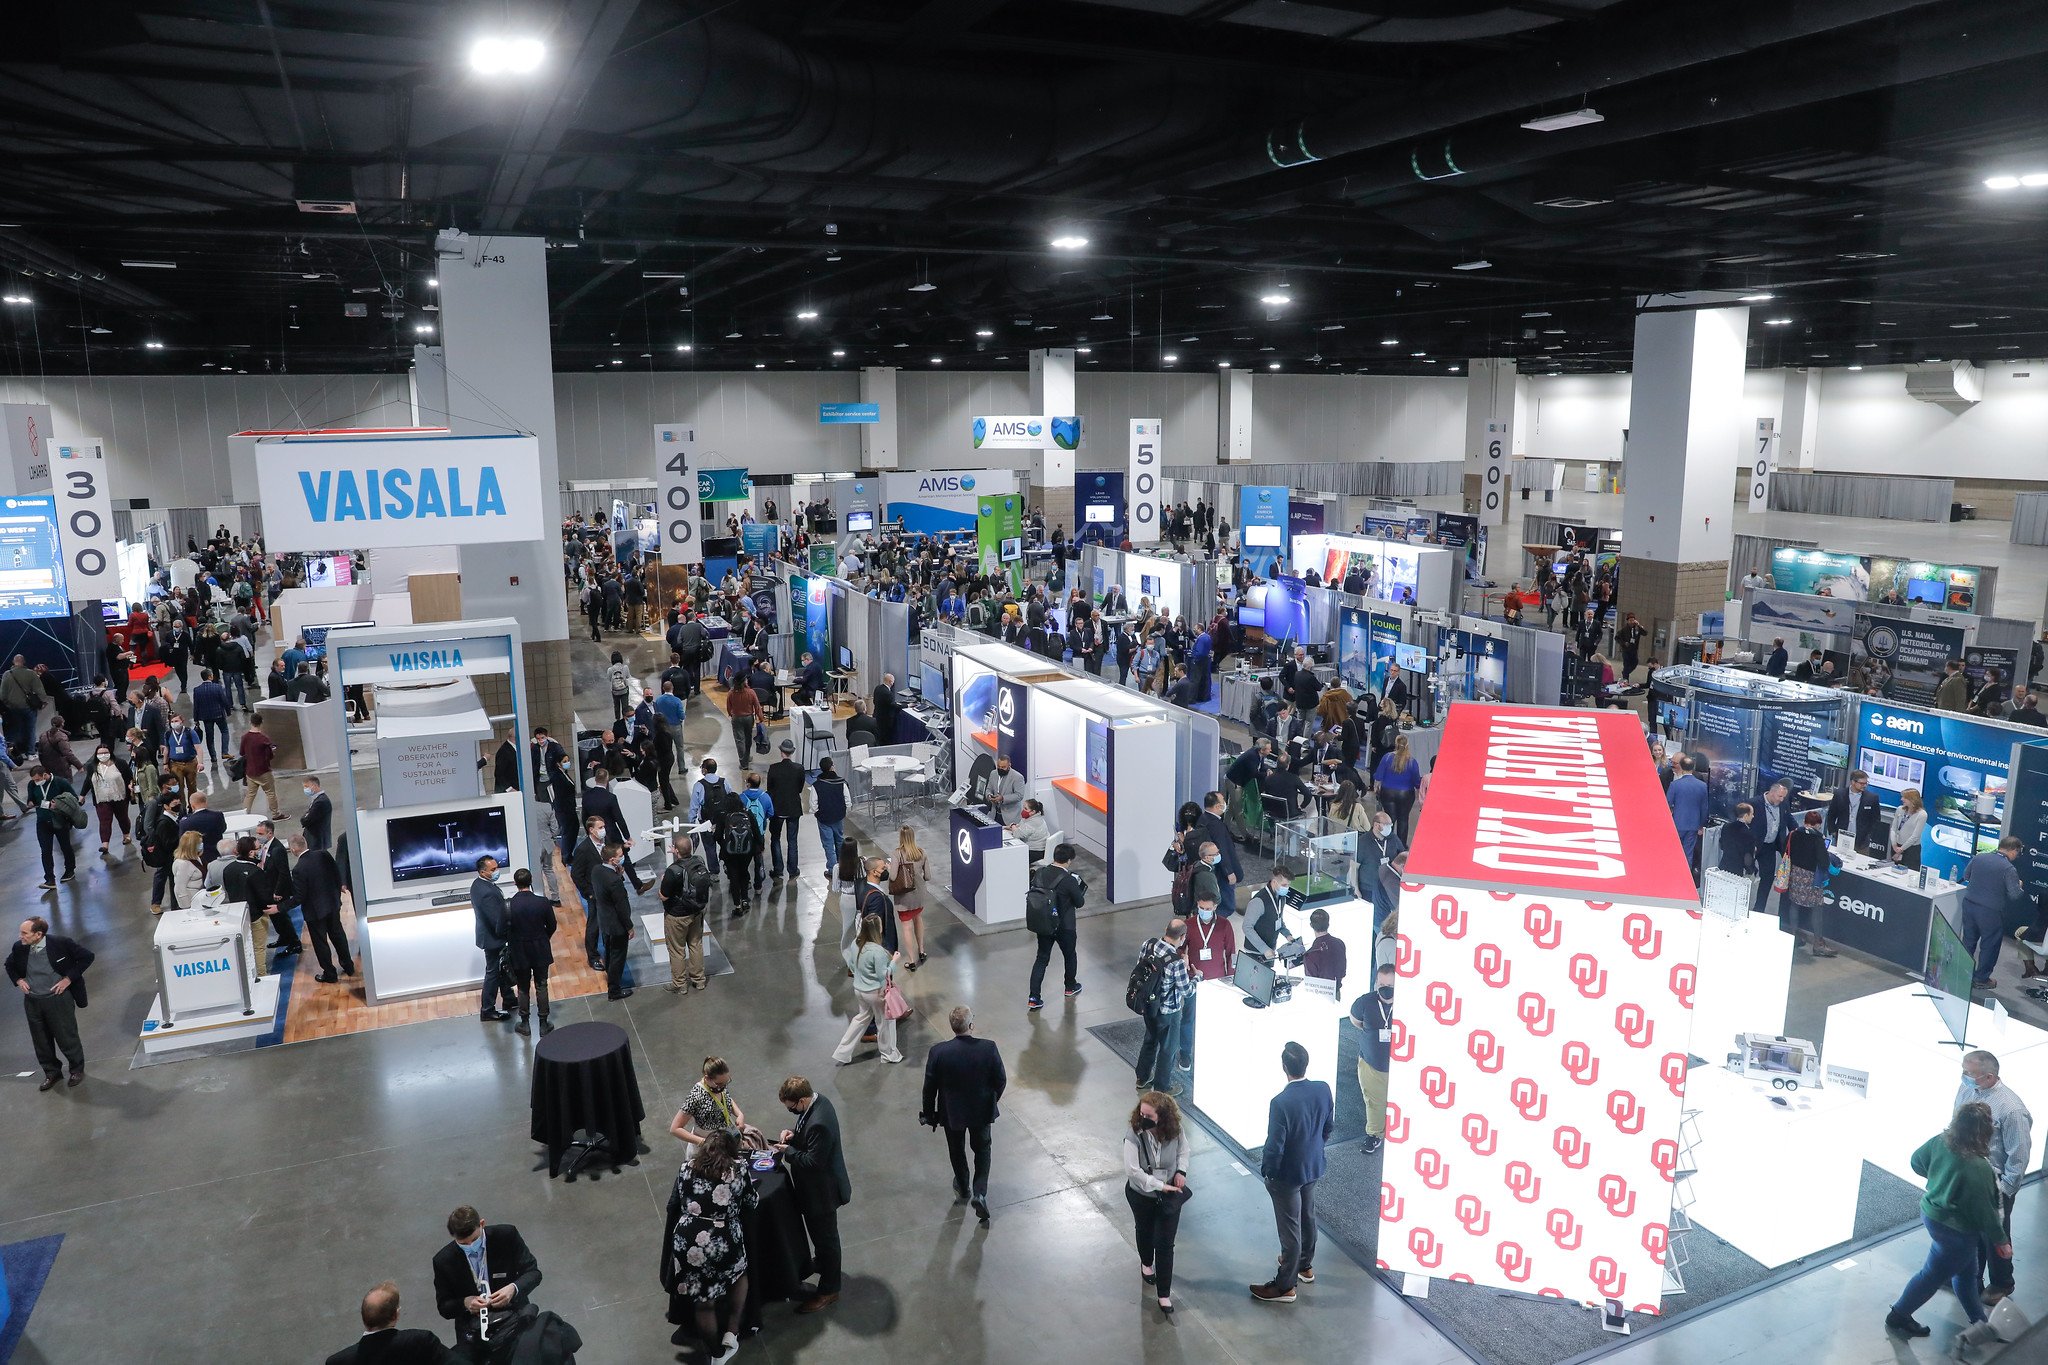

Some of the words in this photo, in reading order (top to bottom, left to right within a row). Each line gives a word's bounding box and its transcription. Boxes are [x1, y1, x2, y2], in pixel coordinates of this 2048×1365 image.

[482, 255, 505, 264] F-43
[993, 422, 1026, 435] AMS
[919, 477, 959, 492] AMS
[1136, 444, 1154, 524] 500
[1486, 440, 1501, 510] 600
[1754, 438, 1768, 499] 700
[298, 466, 506, 522] VAISALA
[666, 452, 692, 544] 400
[66, 470, 106, 576] 300
[1372, 618, 1400, 631] YOUNG
[1901, 638, 1944, 649] METEOROLOGY
[1915, 632, 1935, 640] NAVAL
[390, 649, 464, 672] VAISALA
[923, 636, 954, 656] SONA
[1899, 655, 1929, 665] COMMAND
[1900, 647, 1948, 660] OCEANOGRAPHY
[1886, 716, 1924, 734] aem
[398, 751, 459, 761] OBSERVATIONS
[408, 743, 448, 752] WEATHER
[1870, 733, 1882, 741] The
[1882, 735, 1911, 748] essential
[1912, 742, 1935, 753] source
[1947, 751, 1998, 766] environmental
[403, 768, 457, 778] SUSTAINABLE
[415, 777, 446, 786] FUTURE
[1472, 716, 1626, 879] OKLAHOMA
[1432, 894, 1467, 940] OU
[1525, 904, 1561, 949] OU
[1839, 895, 1884, 923] aem
[1623, 913, 1662, 960] OU
[174, 958, 230, 978] VAISALA
[1475, 943, 1510, 988] OU
[1569, 953, 1607, 999] OU
[1426, 982, 1462, 1025] OU
[1518, 992, 1555, 1037] OU
[1615, 1003, 1654, 1048] OU
[1468, 1030, 1504, 1073] OU
[1562, 1041, 1599, 1085] OU
[1421, 1066, 1455, 1109] OU
[1511, 1078, 1547, 1121] OU
[1607, 1090, 1645, 1134] OU
[1462, 1113, 1497, 1156] OU
[1554, 1126, 1590, 1169] OU
[1415, 1148, 1449, 1190] OU
[1505, 1161, 1540, 1203] OU
[1456, 1195, 1490, 1236] OU
[1599, 1175, 1635, 1217] OU
[1409, 1227, 1442, 1268] OU
[1547, 1208, 1582, 1250] OU
[1496, 1241, 1531, 1282] OU
[1590, 1256, 1626, 1298] OU
